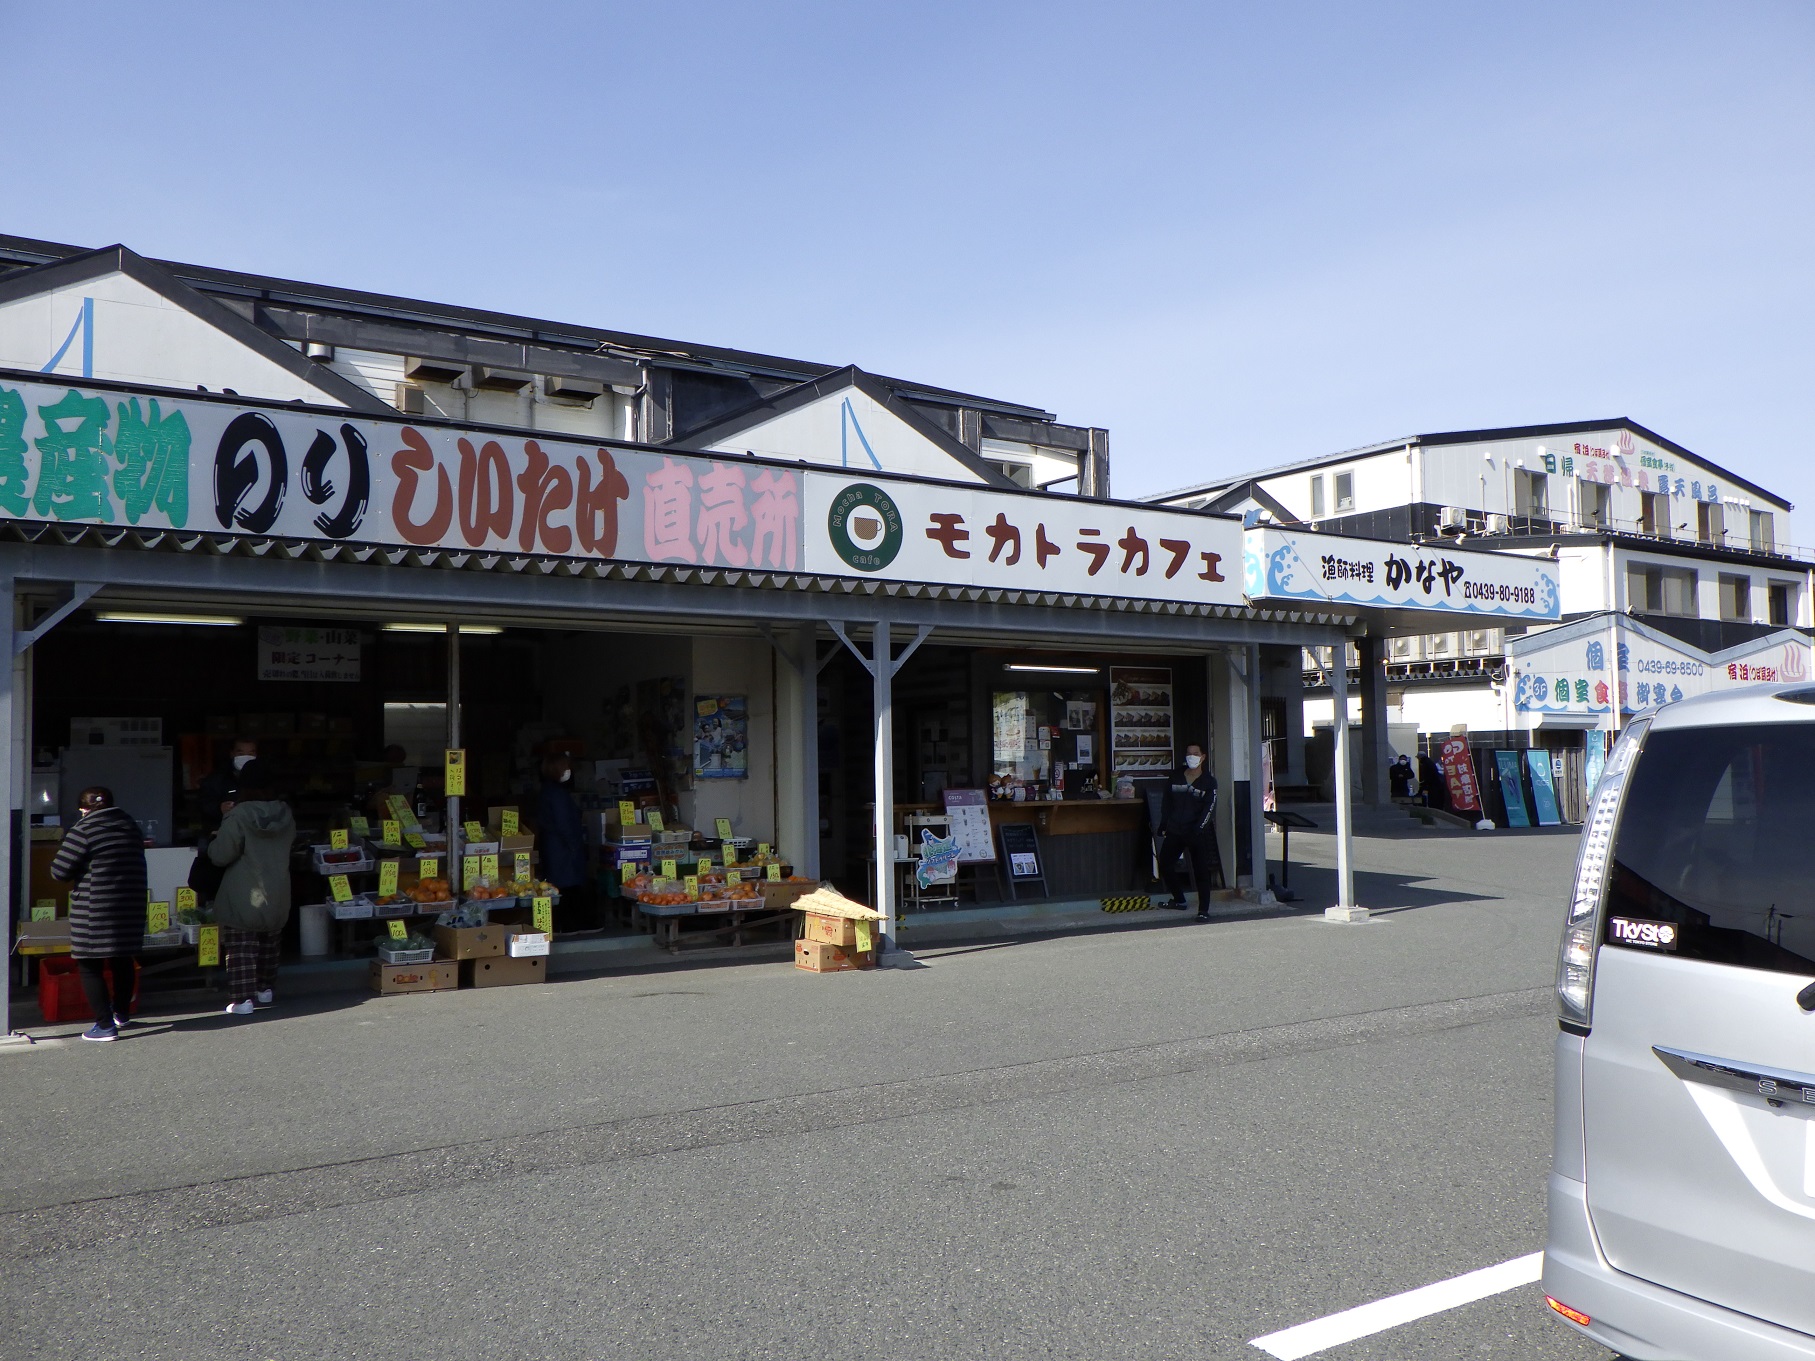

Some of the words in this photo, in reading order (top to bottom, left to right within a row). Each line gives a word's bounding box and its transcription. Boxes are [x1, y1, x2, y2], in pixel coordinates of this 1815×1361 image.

[214, 411, 370, 538] のり
[391, 426, 629, 559] しいたけ
[642, 456, 800, 571] 直売所
[832, 491, 863, 528] Mocha
[873, 493, 899, 533] TORA
[852, 554, 881, 566] cafe
[925, 511, 1226, 583] モカトラカフェ
[1321, 555, 1375, 584] 漁師料理
[1384, 552, 1464, 597] かなや
[1637, 659, 1704, 677] 0439-69-8500
[1534, 683, 1547, 696] 3F
[396, 974, 419, 984] Dole
